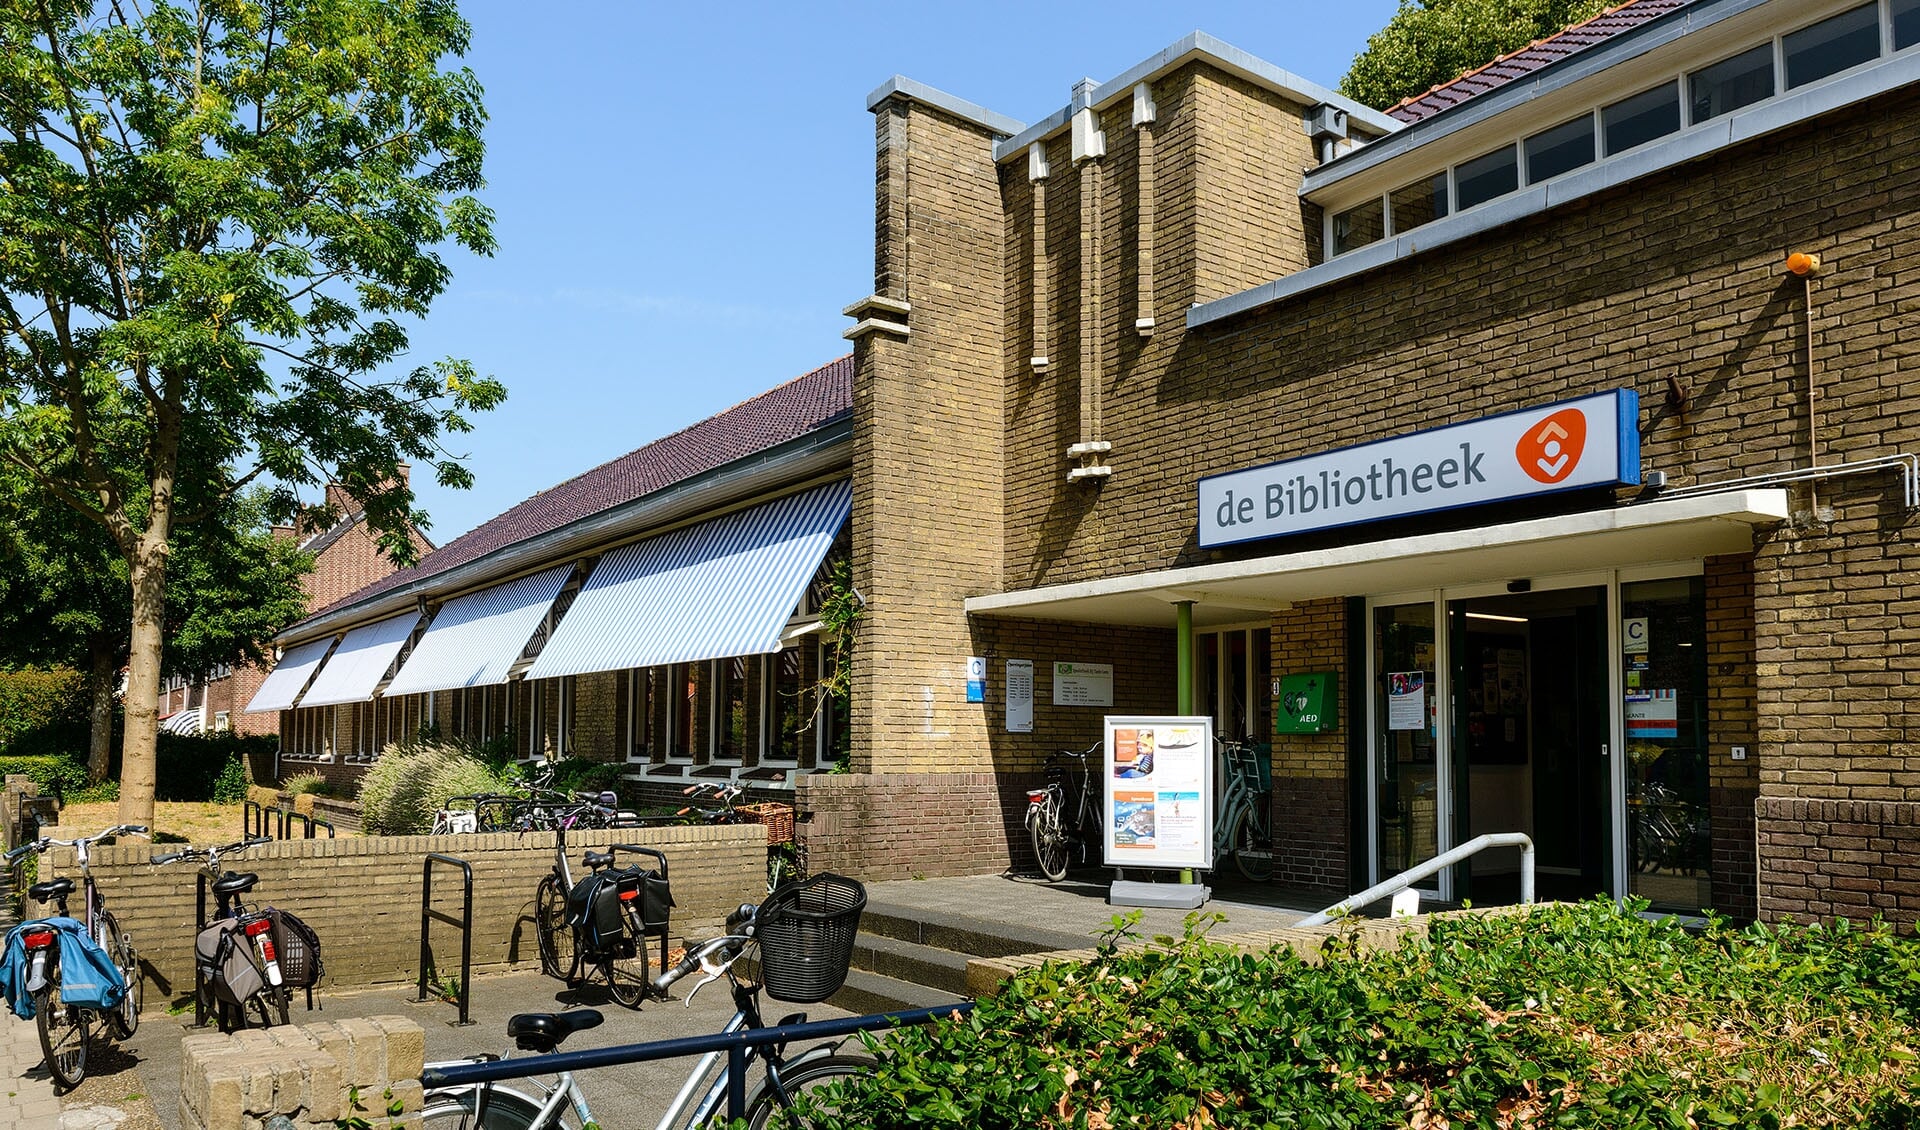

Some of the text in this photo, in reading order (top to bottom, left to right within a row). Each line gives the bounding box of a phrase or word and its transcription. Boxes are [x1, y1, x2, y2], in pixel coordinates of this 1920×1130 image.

[1216, 442, 1487, 528] de Bibliotheek
[1628, 622, 1643, 639] C
[972, 661, 982, 676] C
[1299, 714, 1318, 723] AED
